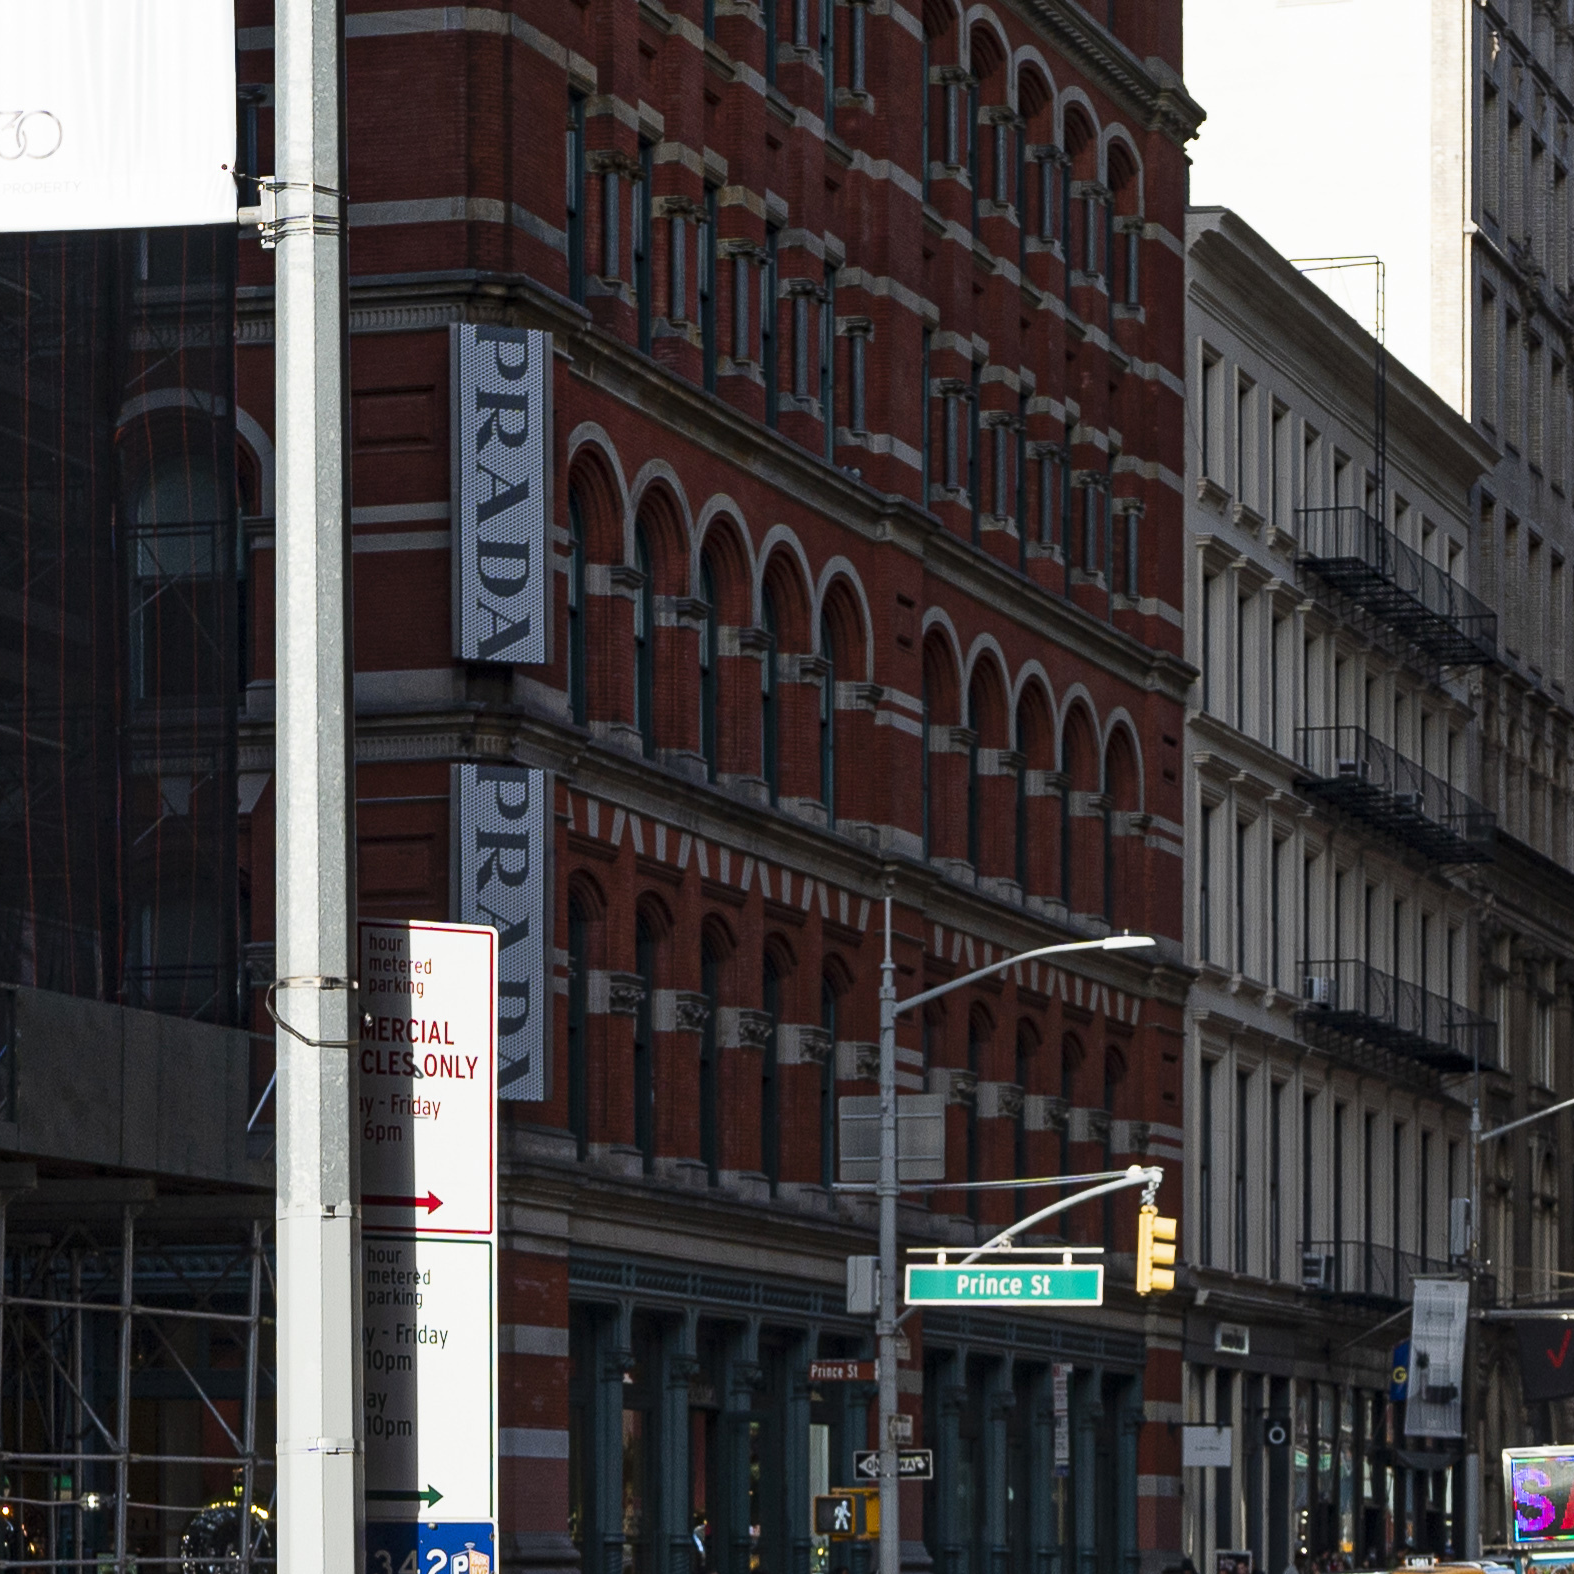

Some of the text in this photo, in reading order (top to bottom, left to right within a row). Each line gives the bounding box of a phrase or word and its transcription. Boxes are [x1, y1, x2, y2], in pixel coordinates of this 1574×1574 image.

[2, 180, 81, 196] PROPERTY
[475, 324, 530, 661] PRADA
[369, 933, 403, 952] hour
[369, 956, 432, 975] metered
[369, 978, 424, 999] parking
[359, 1017, 455, 1045] MERCIAL
[360, 1049, 479, 1080] CLES ONLY
[391, 1095, 441, 1121] Friday
[367, 1245, 402, 1265] hour
[367, 1267, 431, 1286] metered
[956, 1273, 1052, 1296] Prince St
[367, 1287, 423, 1310] parking
[396, 1322, 449, 1350] Friday
[811, 1363, 859, 1379] Prince St
